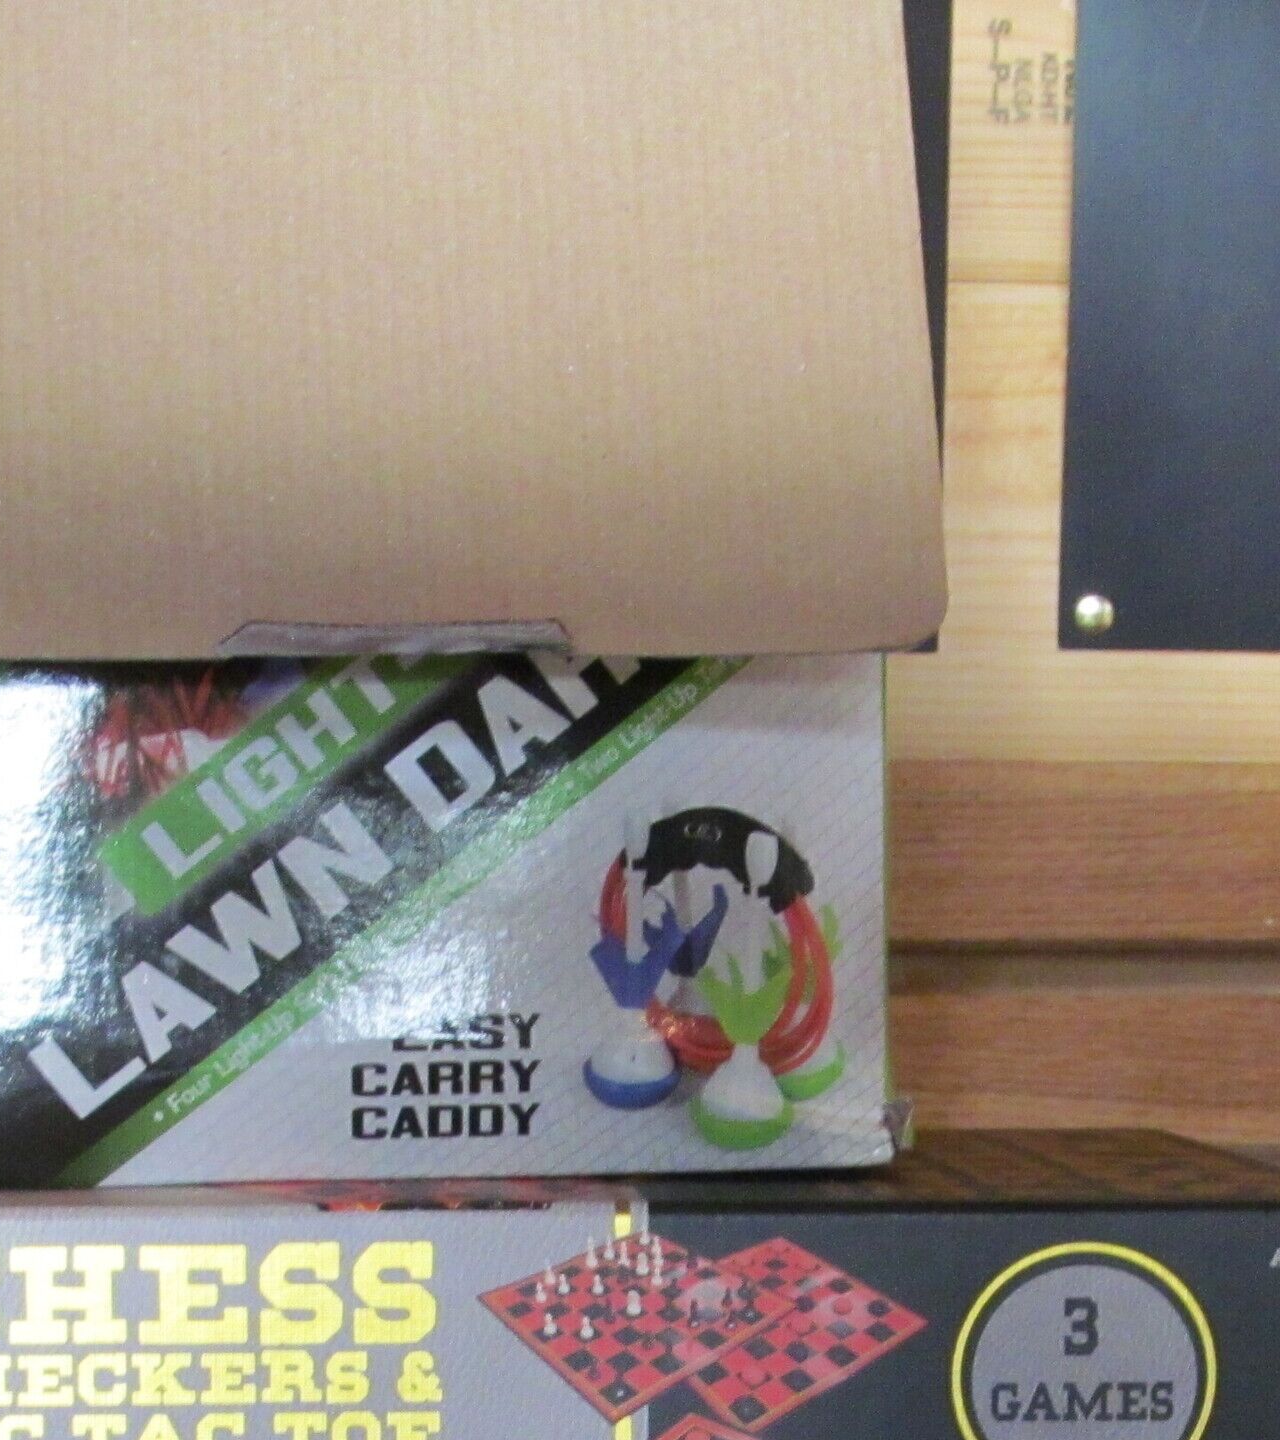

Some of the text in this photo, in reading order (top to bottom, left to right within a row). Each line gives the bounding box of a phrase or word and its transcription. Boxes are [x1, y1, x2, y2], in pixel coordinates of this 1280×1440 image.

[27, 800, 394, 1119] LAWN
[351, 1059, 542, 1096] CARRY
[351, 1103, 541, 1139] CADDY
[1064, 1297, 1100, 1356] 3
[397, 1350, 443, 1403] &
[991, 1381, 1175, 1423] GAMES
